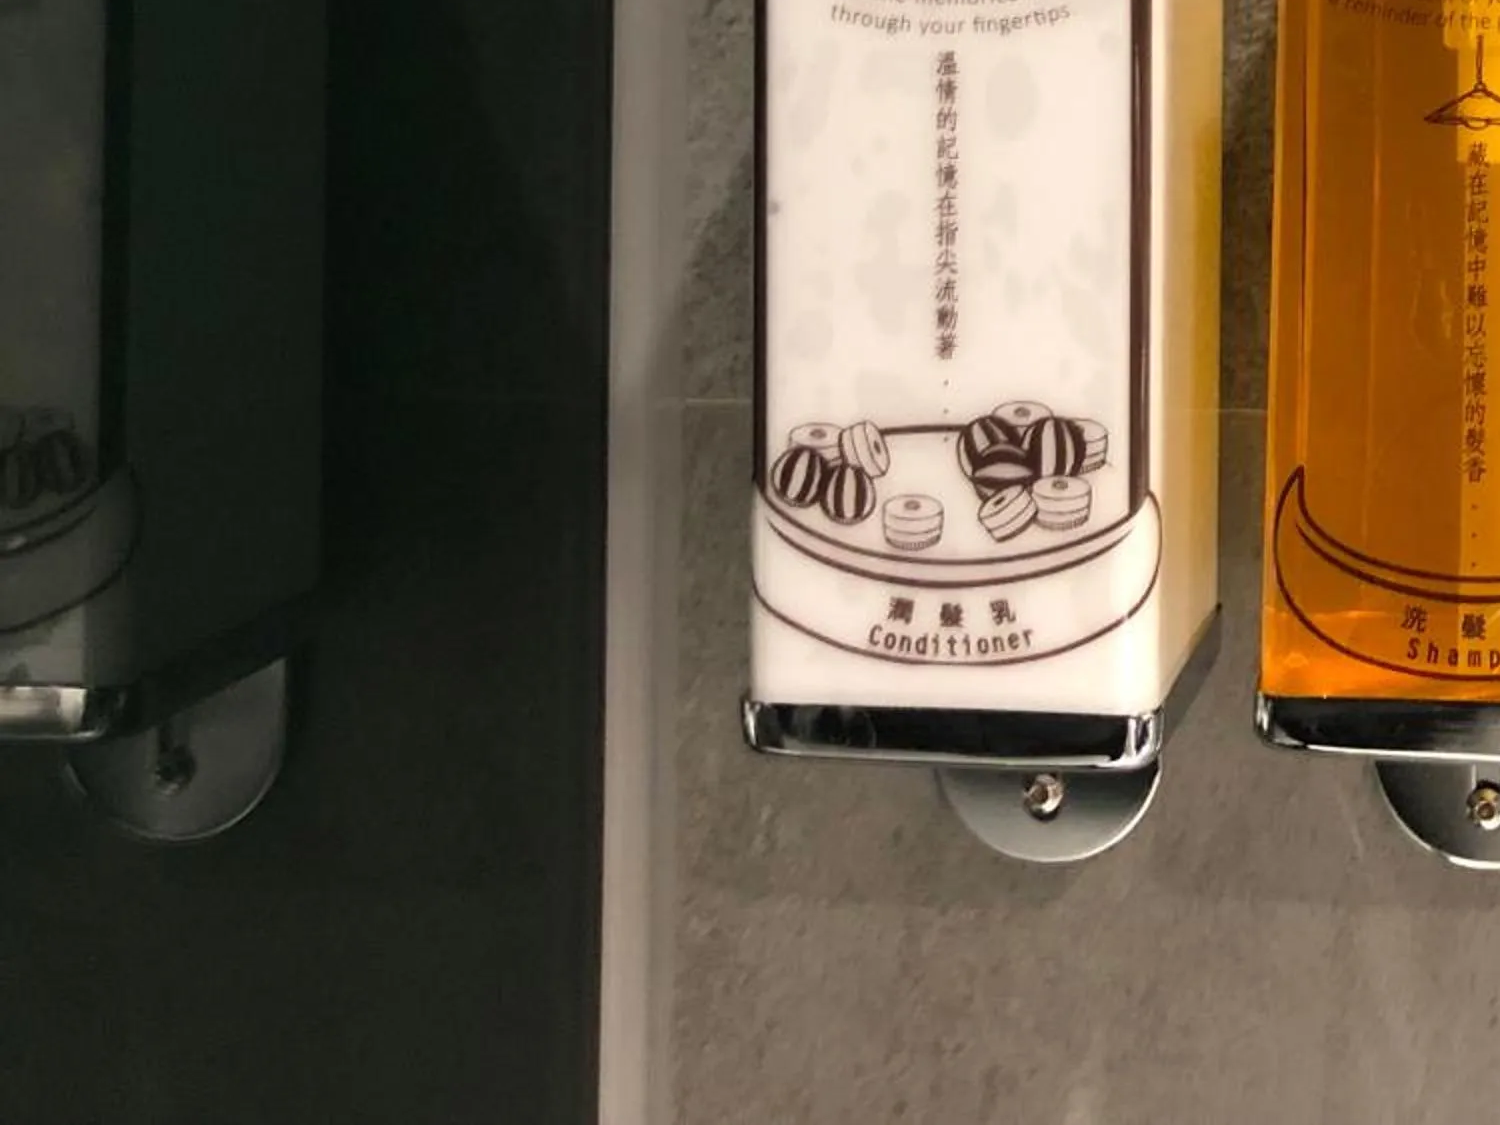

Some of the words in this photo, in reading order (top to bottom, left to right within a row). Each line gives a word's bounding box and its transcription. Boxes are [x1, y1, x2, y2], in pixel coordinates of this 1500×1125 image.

[830, 4, 912, 36] through
[918, 17, 966, 36] your
[1460, 9, 1492, 30] the
[867, 623, 1034, 657] Conditioner
